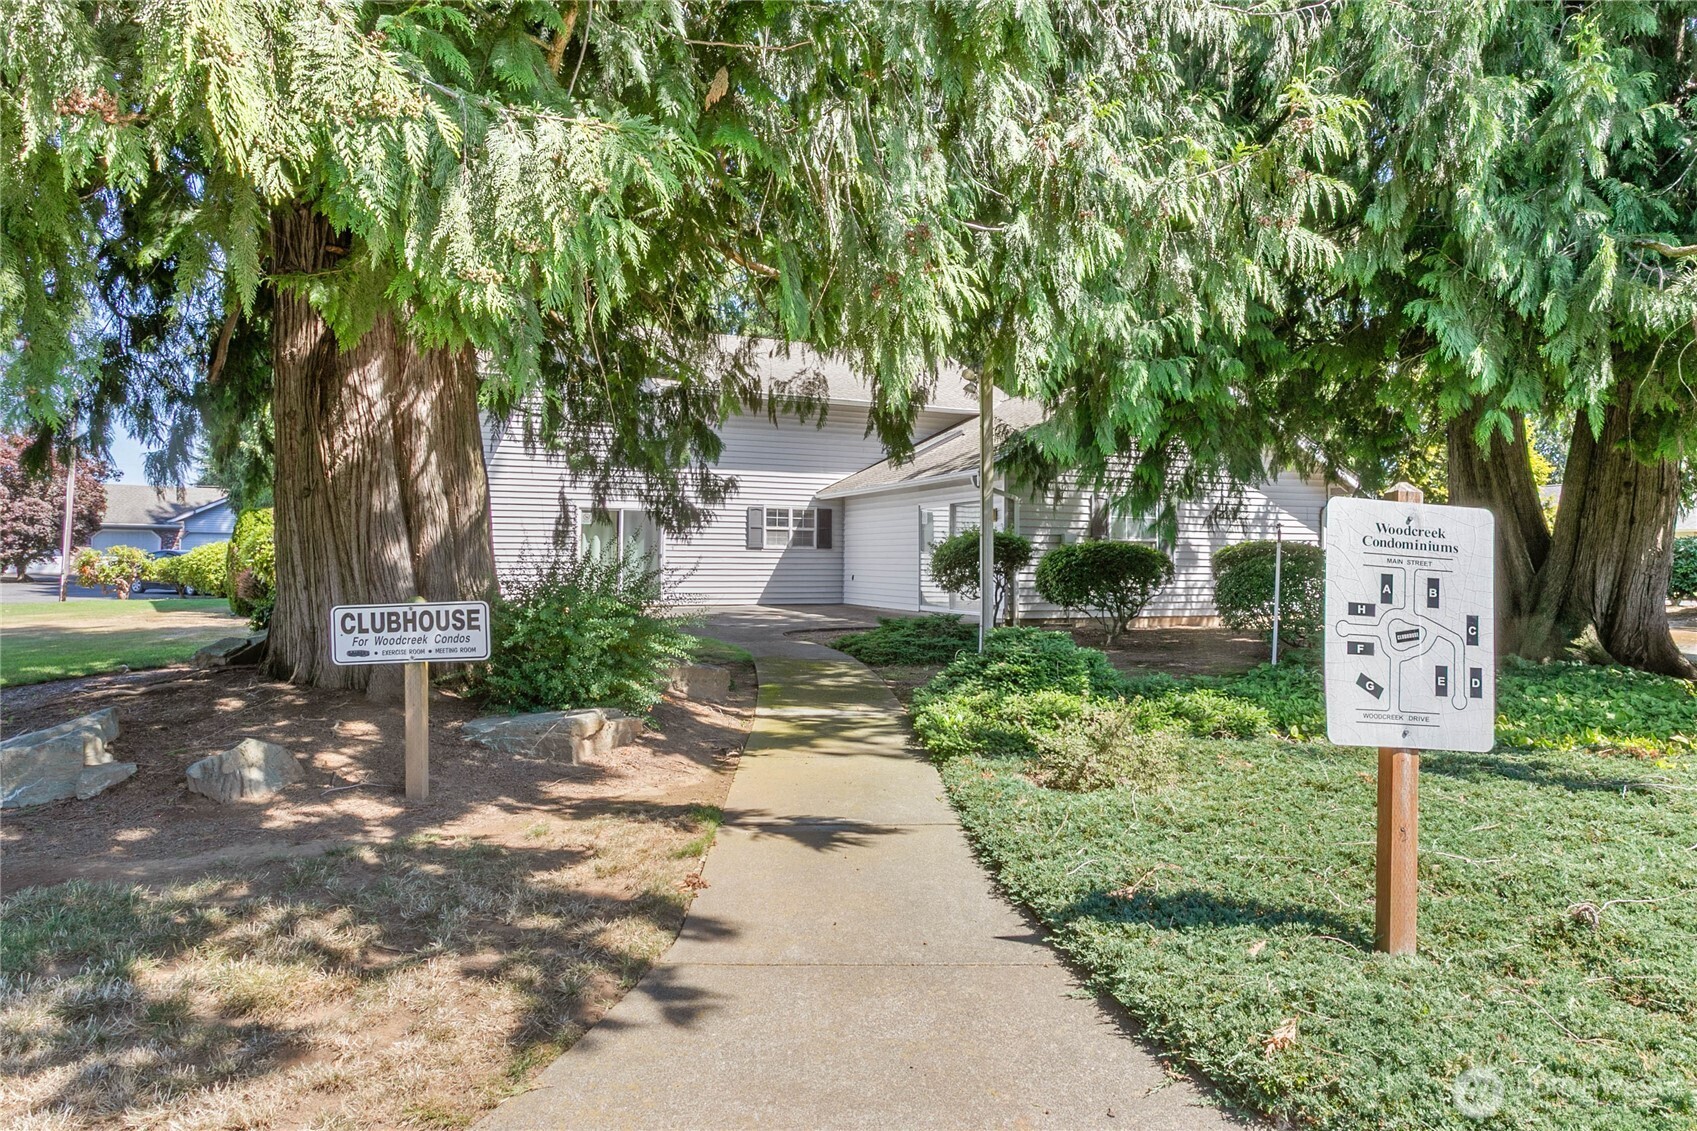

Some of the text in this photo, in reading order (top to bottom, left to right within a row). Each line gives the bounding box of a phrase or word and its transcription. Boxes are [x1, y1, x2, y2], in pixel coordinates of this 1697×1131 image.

[1376, 522, 1446, 539] Woodcreek
[1362, 535, 1459, 553] Condominiums
[1407, 559, 1432, 567] STREET
[1382, 584, 1391, 594] A
[1429, 588, 1437, 598] B
[1357, 605, 1366, 614] H
[340, 609, 481, 635] CLUBHOUSE
[1468, 626, 1477, 636] C
[352, 634, 471, 647] For Woodcreek Condos
[1356, 644, 1364, 654] F
[1365, 681, 1375, 691] G
[1437, 676, 1446, 686] E
[1471, 678, 1480, 688] D
[1363, 713, 1430, 723] WOODCREEK DRIVE
